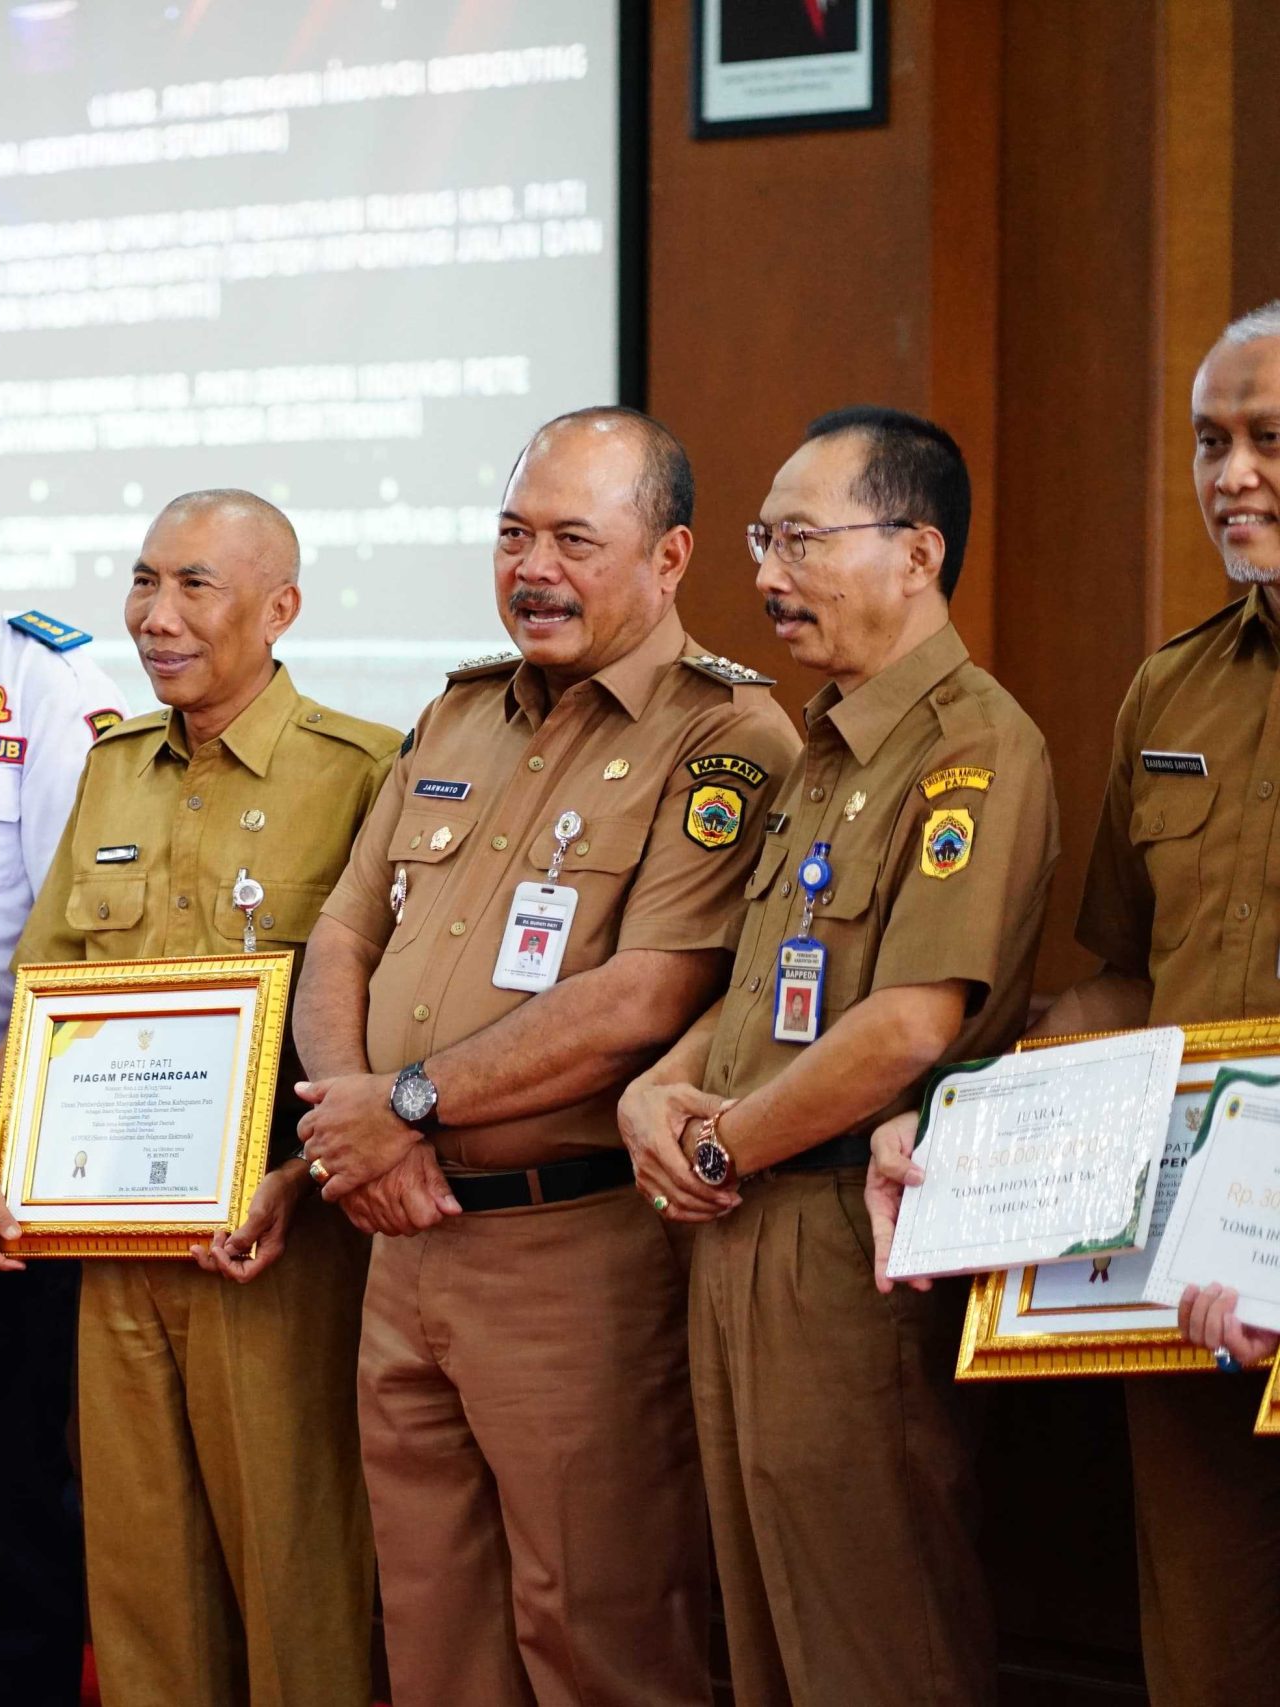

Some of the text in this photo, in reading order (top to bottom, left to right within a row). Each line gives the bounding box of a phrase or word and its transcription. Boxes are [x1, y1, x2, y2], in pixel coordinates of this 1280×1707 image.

[697, 759, 758, 781] KAB. PATI
[1145, 758, 1201, 771] BAMBANG SANTOSO
[422, 784, 459, 794] JARWANTO
[945, 778, 968, 789] PATI
[785, 969, 817, 980] BAPPEDA
[110, 1058, 172, 1070] BUPATI PATI
[73, 1070, 208, 1083] PIAGAM PENGHARGAAN
[1165, 1142, 1193, 1153] PAT
